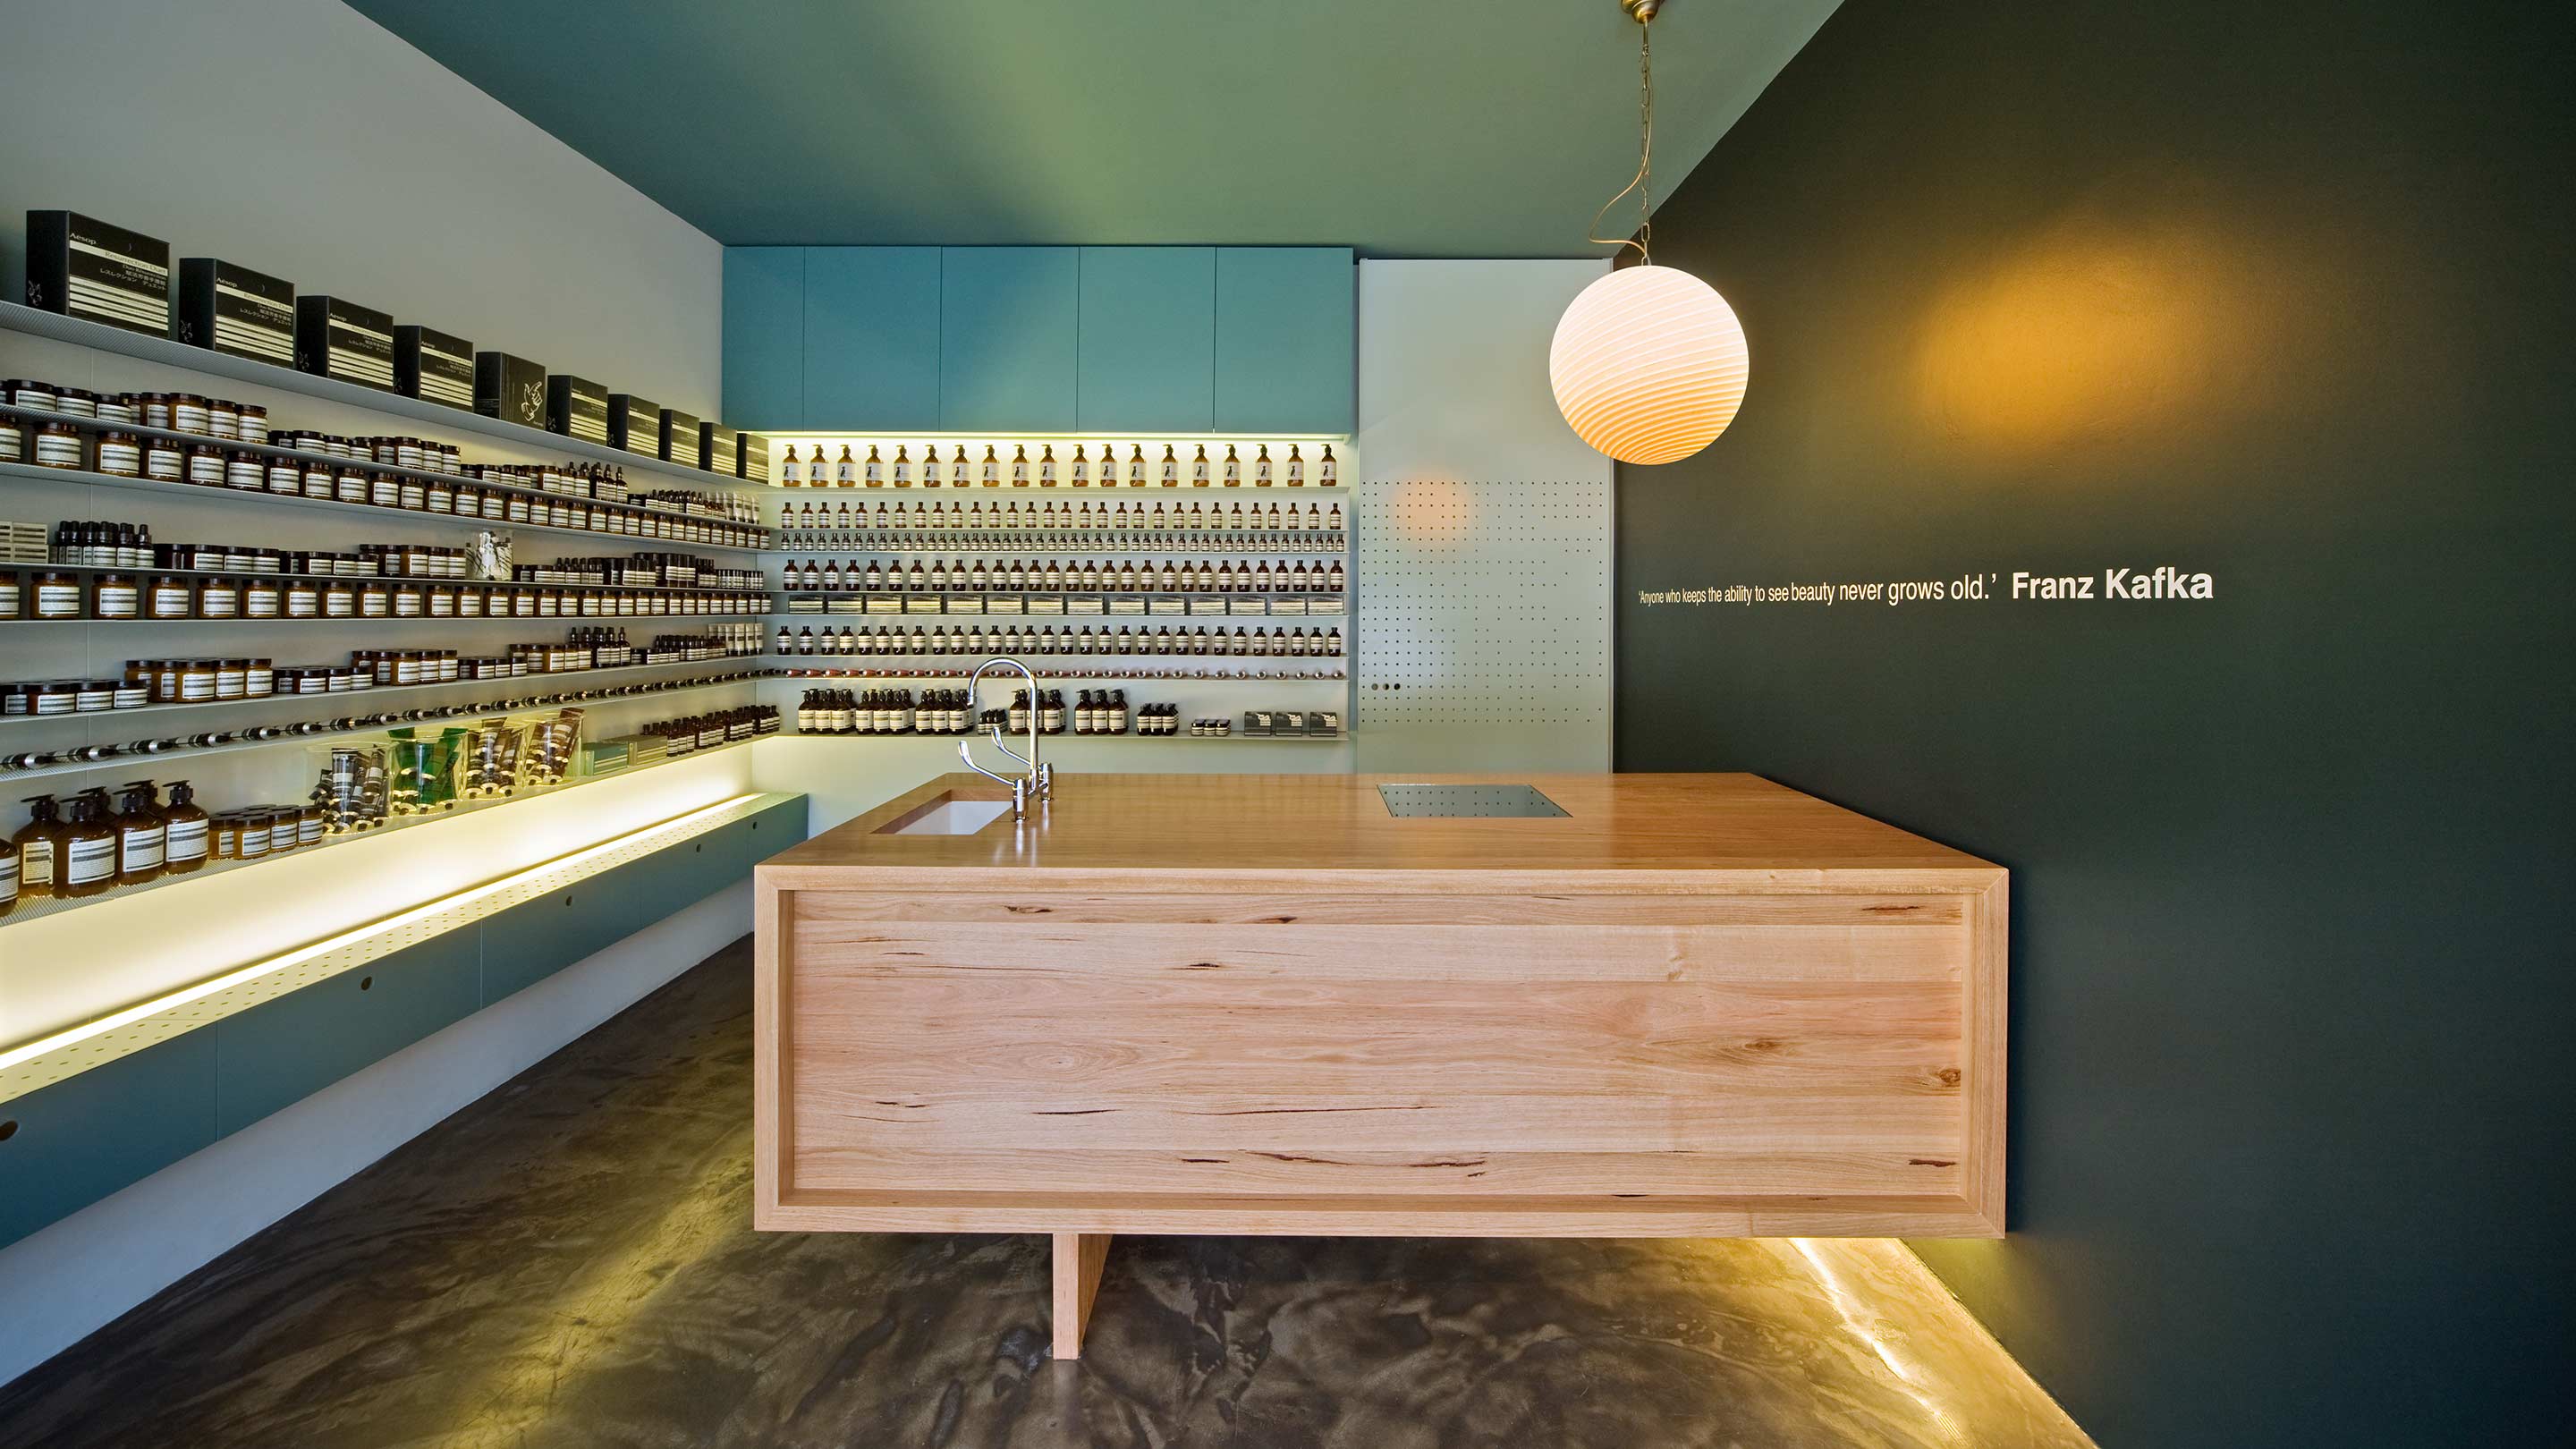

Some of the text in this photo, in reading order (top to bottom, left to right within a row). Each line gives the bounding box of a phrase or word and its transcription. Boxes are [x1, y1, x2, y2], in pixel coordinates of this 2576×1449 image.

[106, 251, 166, 274] Resurrection Duet
[1638, 566, 2216, 607] ‘Anyone who keeps the ability to see beauty never grows old.’ Franz Kafka
